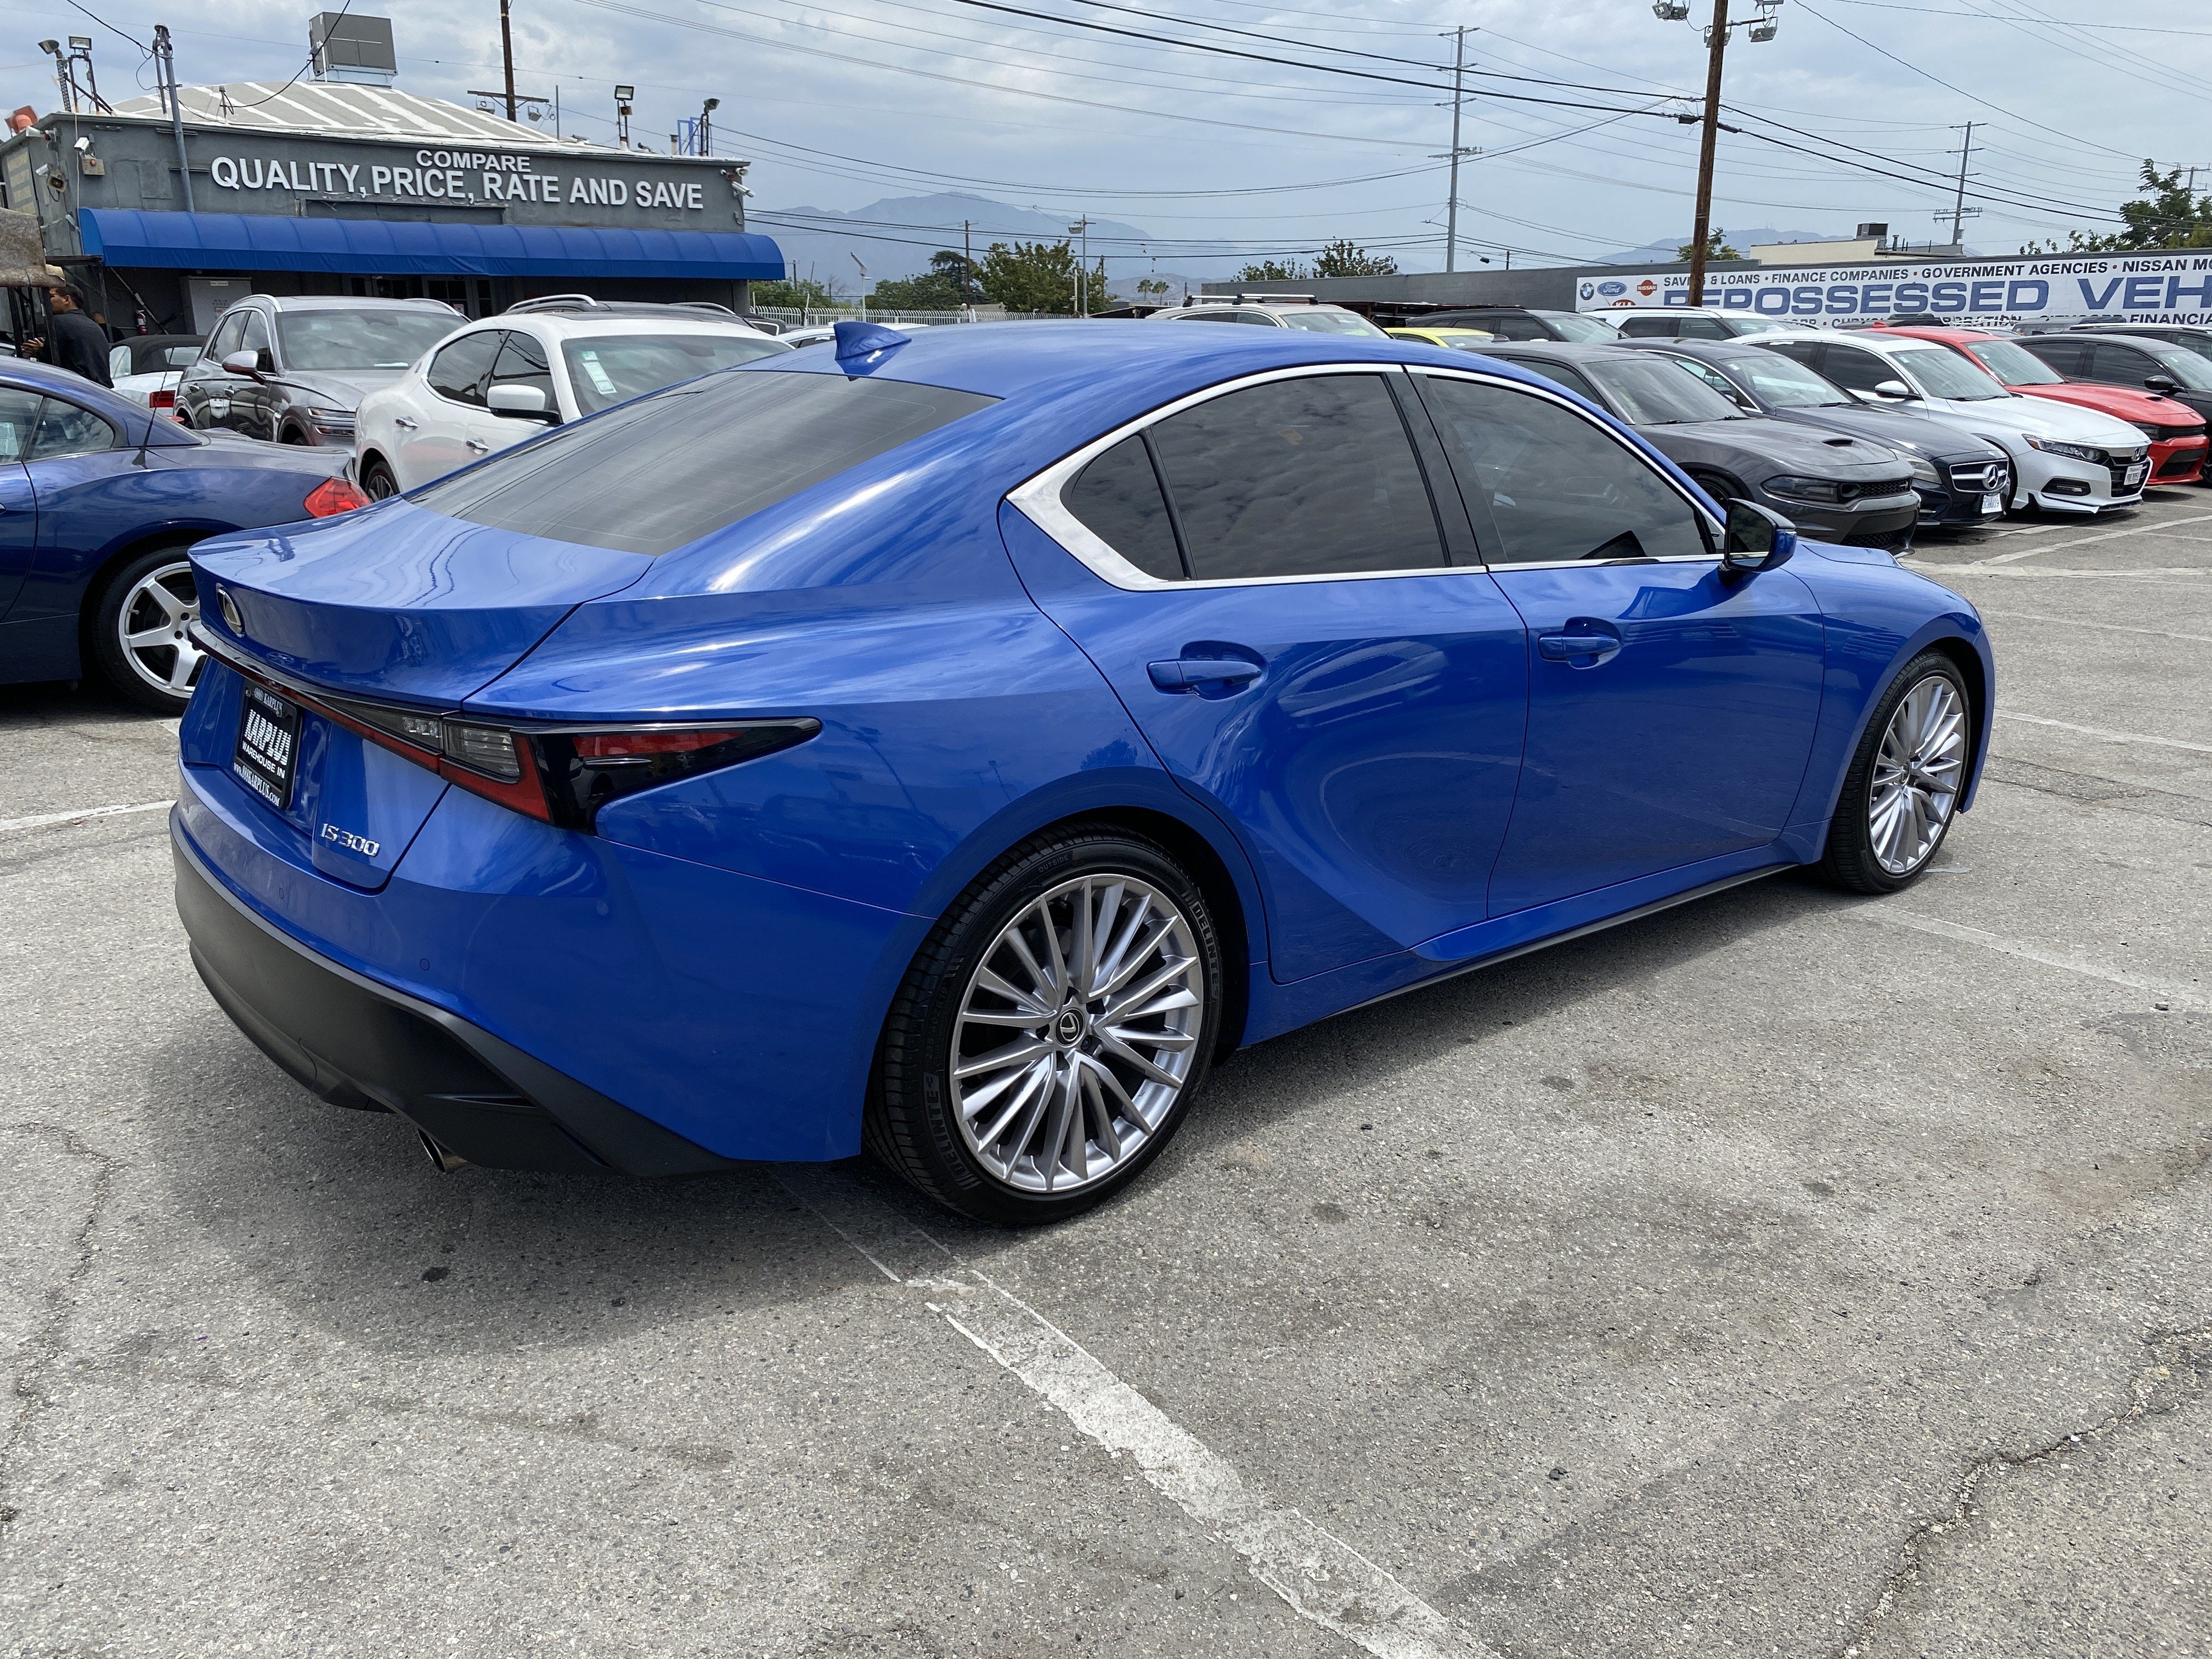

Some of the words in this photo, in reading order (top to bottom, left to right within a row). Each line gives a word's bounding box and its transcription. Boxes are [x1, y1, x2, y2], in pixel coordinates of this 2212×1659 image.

[416, 150, 531, 172] COMPARE
[211, 156, 367, 199] QUALITY,
[371, 166, 474, 204] PRICE,
[483, 172, 560, 202] RATE
[569, 177, 628, 205] AND
[635, 181, 703, 209] SAVE
[1711, 276, 1717, 284] &
[1721, 274, 1760, 284] LOANS
[1771, 272, 1826, 283] FINANCE
[1830, 269, 1909, 281] COMPANIES
[1922, 265, 2024, 278] GOVERNMENT
[2029, 262, 2108, 274] AGENCIES
[2122, 259, 2187, 272] NISSAN
[1604, 284, 1621, 293] Ford
[244, 709, 291, 765] KARPLUS
[242, 741, 276, 773] WAREHOUSE
[321, 823, 340, 842] IS
[338, 831, 380, 856] 300
[1039, 854, 1068, 873] OUTSIDE
[1192, 902, 1221, 986] DELINTE
